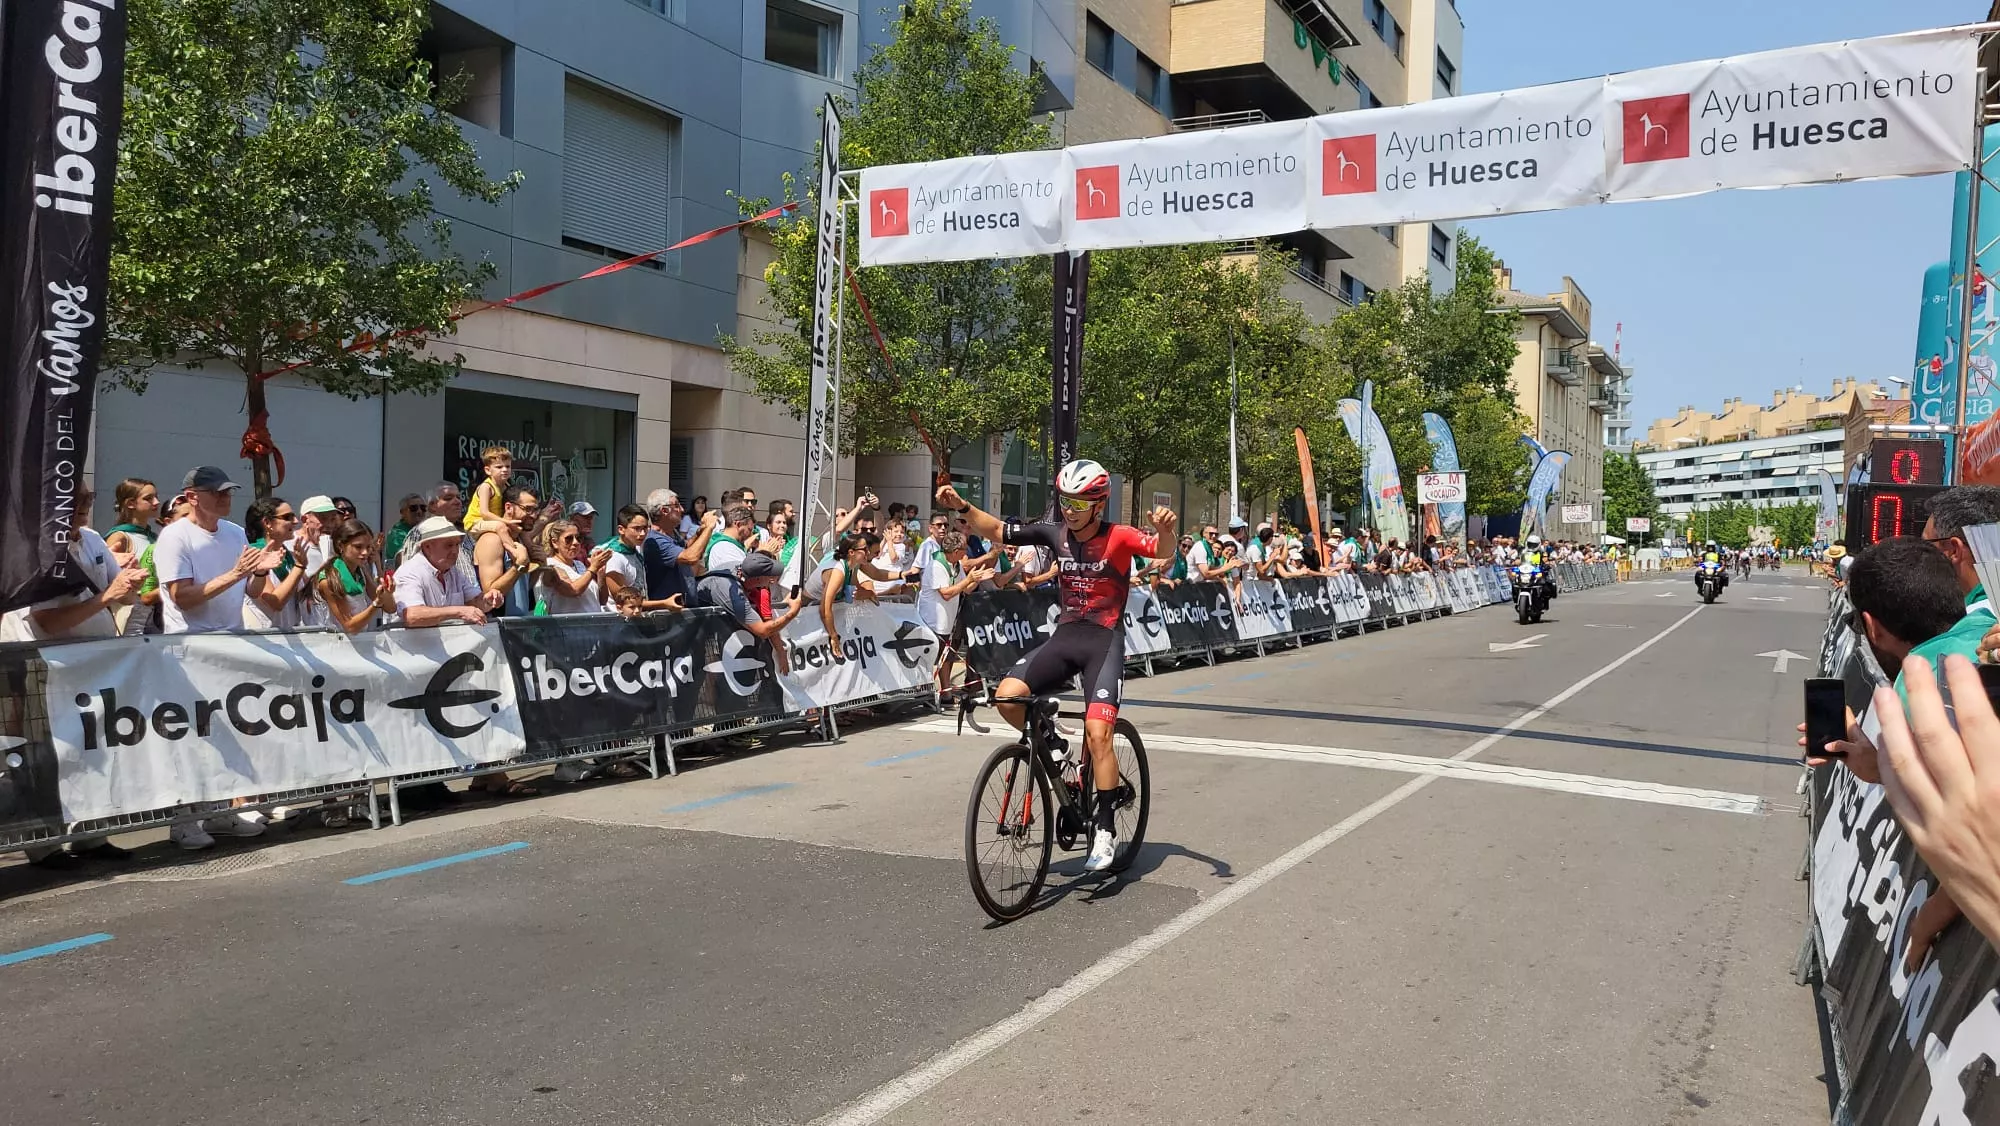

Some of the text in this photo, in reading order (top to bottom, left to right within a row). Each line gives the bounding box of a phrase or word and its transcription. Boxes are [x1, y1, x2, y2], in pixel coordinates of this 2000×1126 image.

[1700, 70, 1953, 122] Ayuntamiento
[1385, 115, 1592, 162] Ayuntamiento
[1700, 117, 1888, 156] de Huesca
[1127, 152, 1296, 191] Ayuntamiento
[1385, 158, 1538, 191] de Huesca
[914, 177, 1053, 211] Ayuntamiento
[1127, 190, 1254, 217] de Huesca
[915, 211, 1020, 235] de Huesca
[57, 407, 75, 451] DEL
[1449, 473, 1460, 485] M
[1891, 449, 1920, 485] 0
[55, 460, 75, 544] BANCO
[966, 612, 1033, 649] erCaja
[1161, 600, 1210, 631] iberCaja
[521, 645, 694, 701] iberCaja
[75, 675, 366, 750] iberCaja
